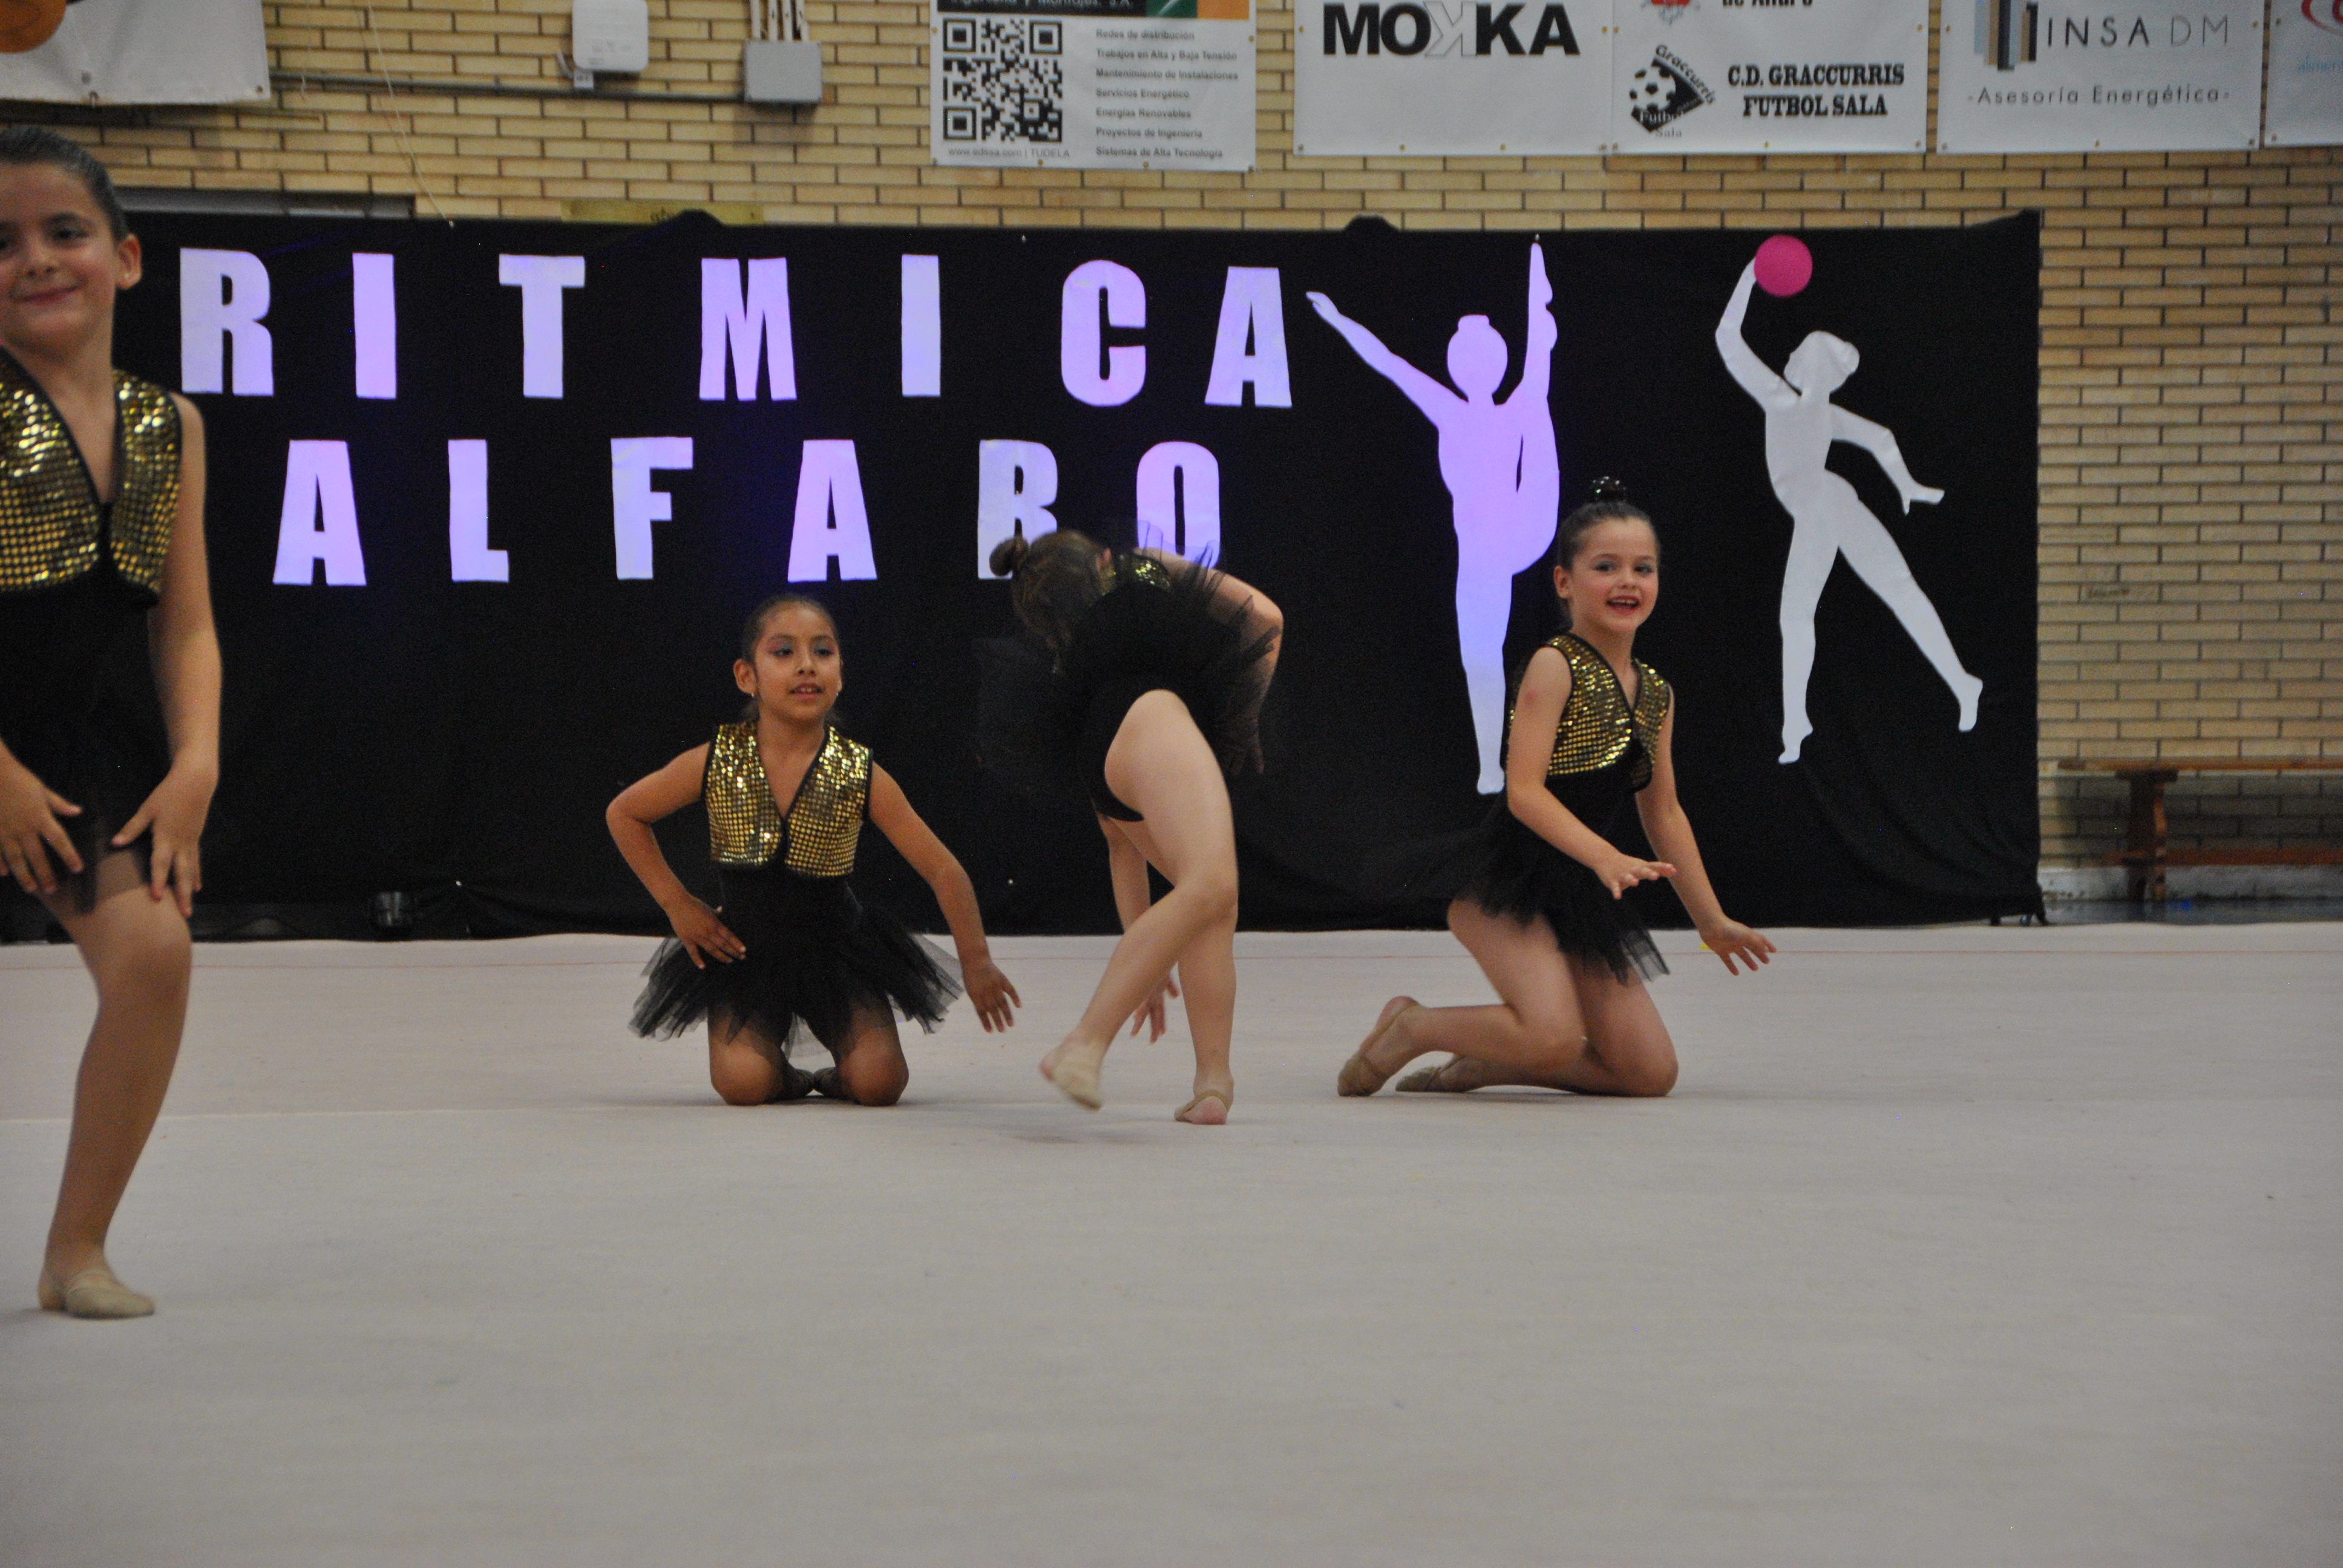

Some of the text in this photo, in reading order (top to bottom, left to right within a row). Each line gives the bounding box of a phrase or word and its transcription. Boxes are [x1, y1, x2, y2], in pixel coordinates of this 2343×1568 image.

[1096, 29, 1124, 38] Redes
[1127, 30, 1138, 39] de
[2048, 15, 2228, 47] INSA DM
[1096, 48, 1135, 59] Trabajos
[1150, 49, 1168, 59] Alta
[1171, 51, 1176, 61] y
[1179, 50, 1199, 61] Baja
[1202, 50, 1237, 60] Tensión
[1096, 68, 1239, 79] Mantenimiento de Instalaciones
[1728, 63, 1904, 87] C.D. GRACCURRIS
[1096, 87, 1190, 100] Servicios Energético
[1743, 93, 1887, 117] FUTBOL SALA
[1138, 108, 1191, 118] Renovables
[1096, 127, 1141, 138] Proyectos
[1144, 129, 1155, 137] de
[1031, 149, 1070, 158] TUDELA
[1096, 146, 1137, 156] Sistemas
[1140, 148, 1150, 157] de
[1153, 148, 1171, 157] Alta
[180, 247, 1292, 407] RITMICA
[272, 436, 1221, 586] ALFARO
